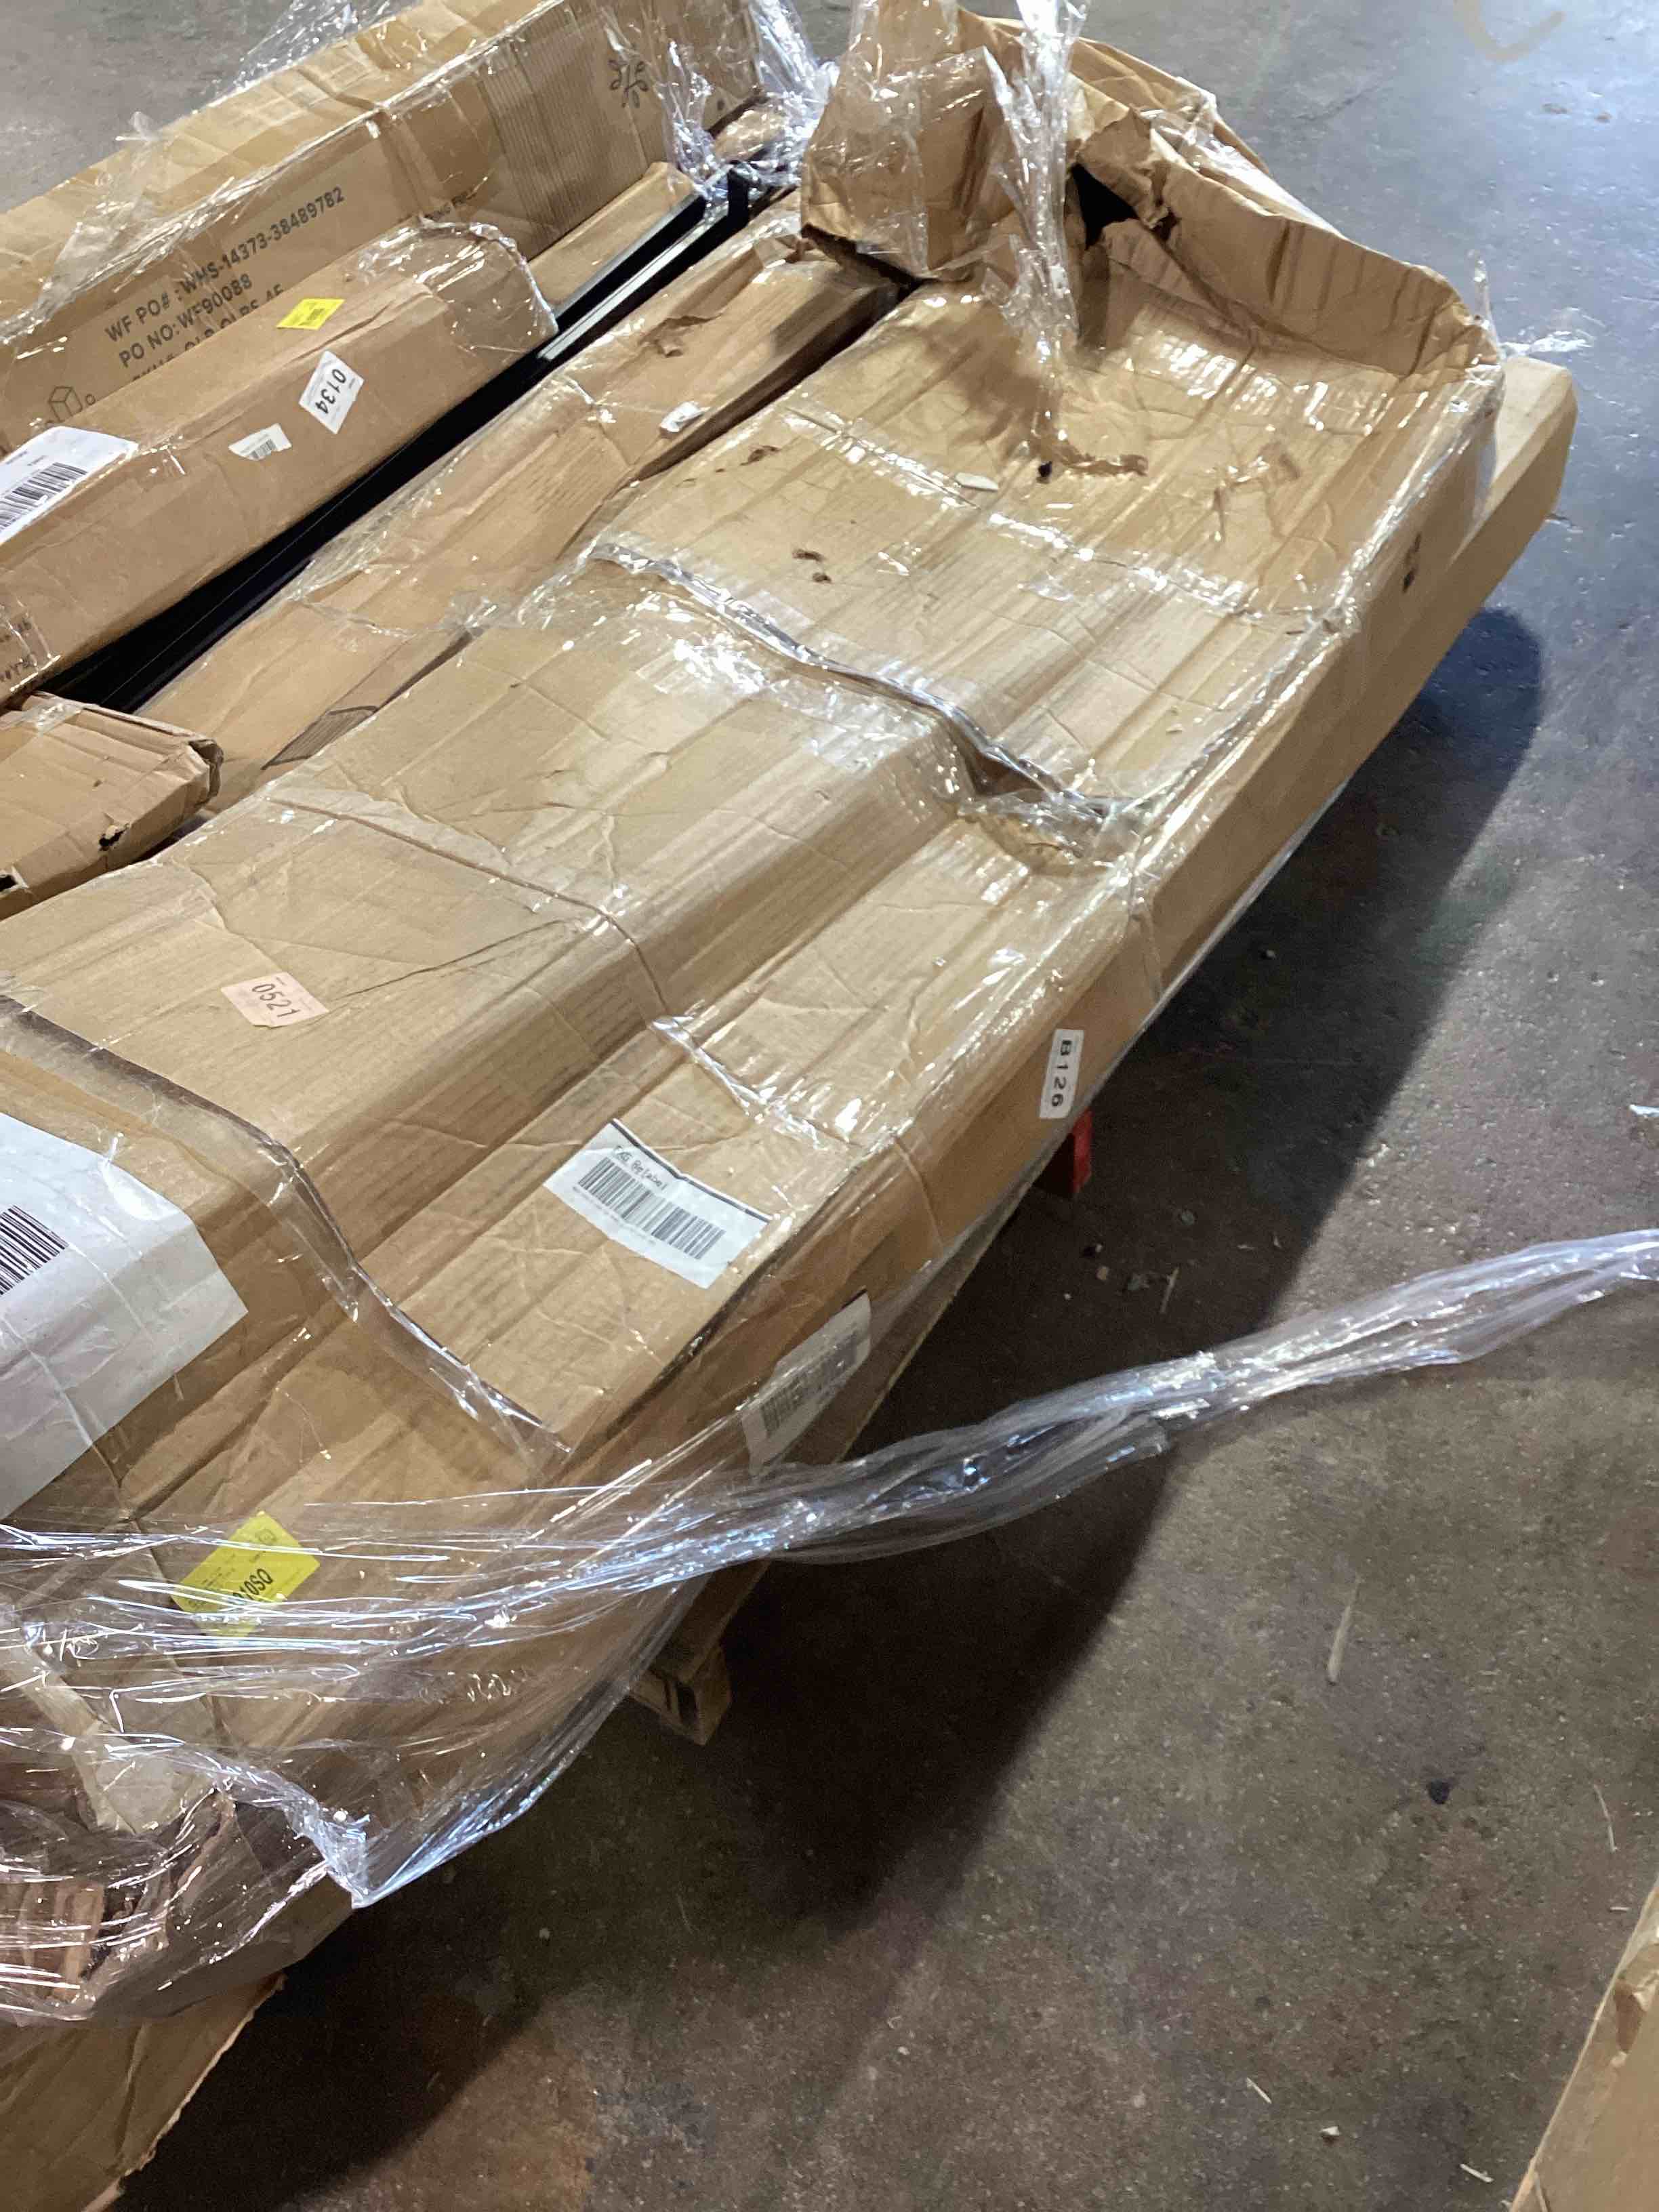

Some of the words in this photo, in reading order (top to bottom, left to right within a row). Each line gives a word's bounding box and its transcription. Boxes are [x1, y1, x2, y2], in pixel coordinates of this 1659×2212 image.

[105, 316, 134, 342] WF
[119, 342, 145, 368] PO
[314, 368, 347, 415] 0134
[251, 983, 301, 1018] 0521
[1051, 1039, 1072, 1107] B126
